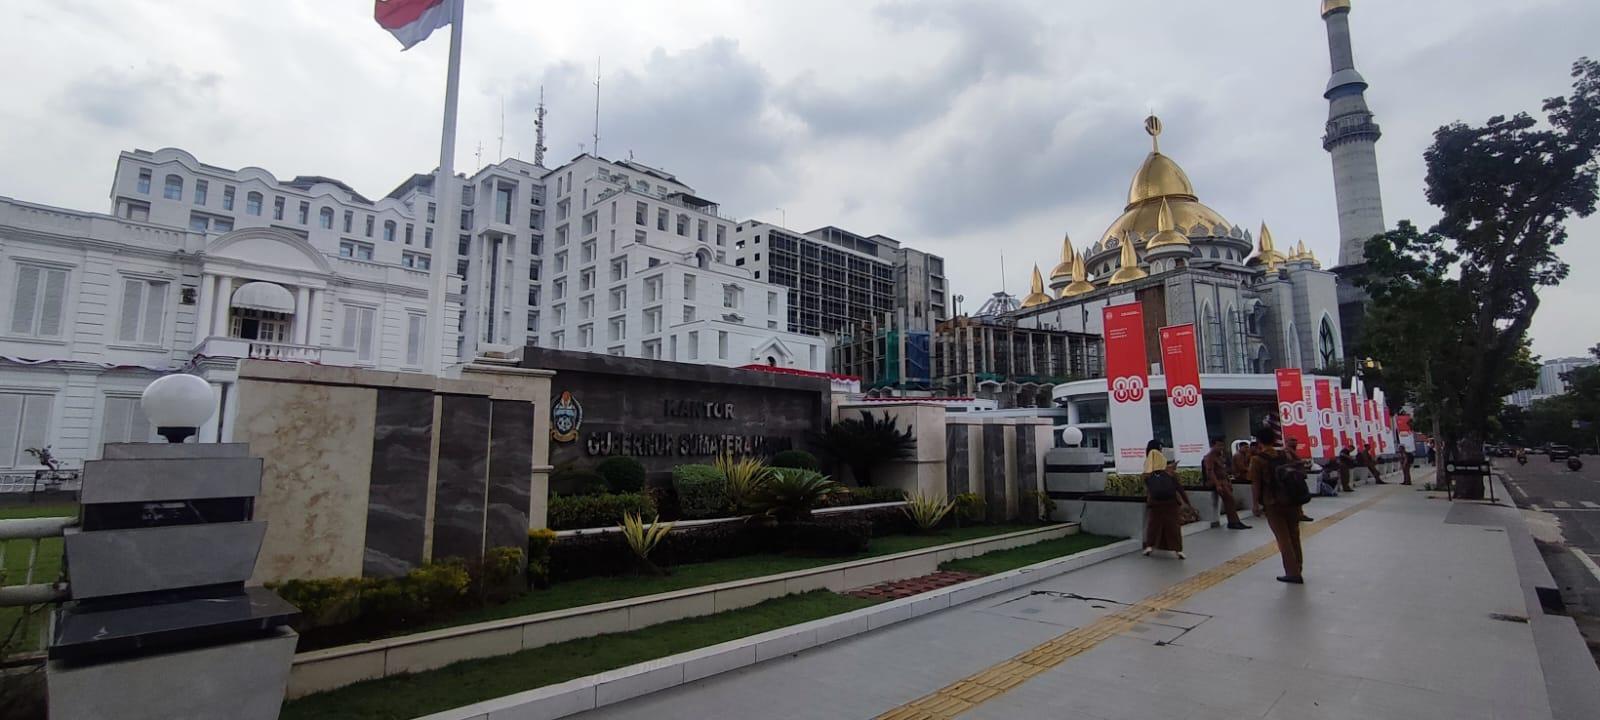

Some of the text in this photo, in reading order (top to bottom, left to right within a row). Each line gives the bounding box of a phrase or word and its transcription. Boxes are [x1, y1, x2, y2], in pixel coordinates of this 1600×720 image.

[1113, 375, 1144, 403] 80
[1171, 384, 1198, 408] 80
[664, 400, 736, 420] KANTOR
[1279, 401, 1306, 426] 80
[587, 431, 673, 457] GUBERNUR
[678, 433, 752, 456] SUMATERA
